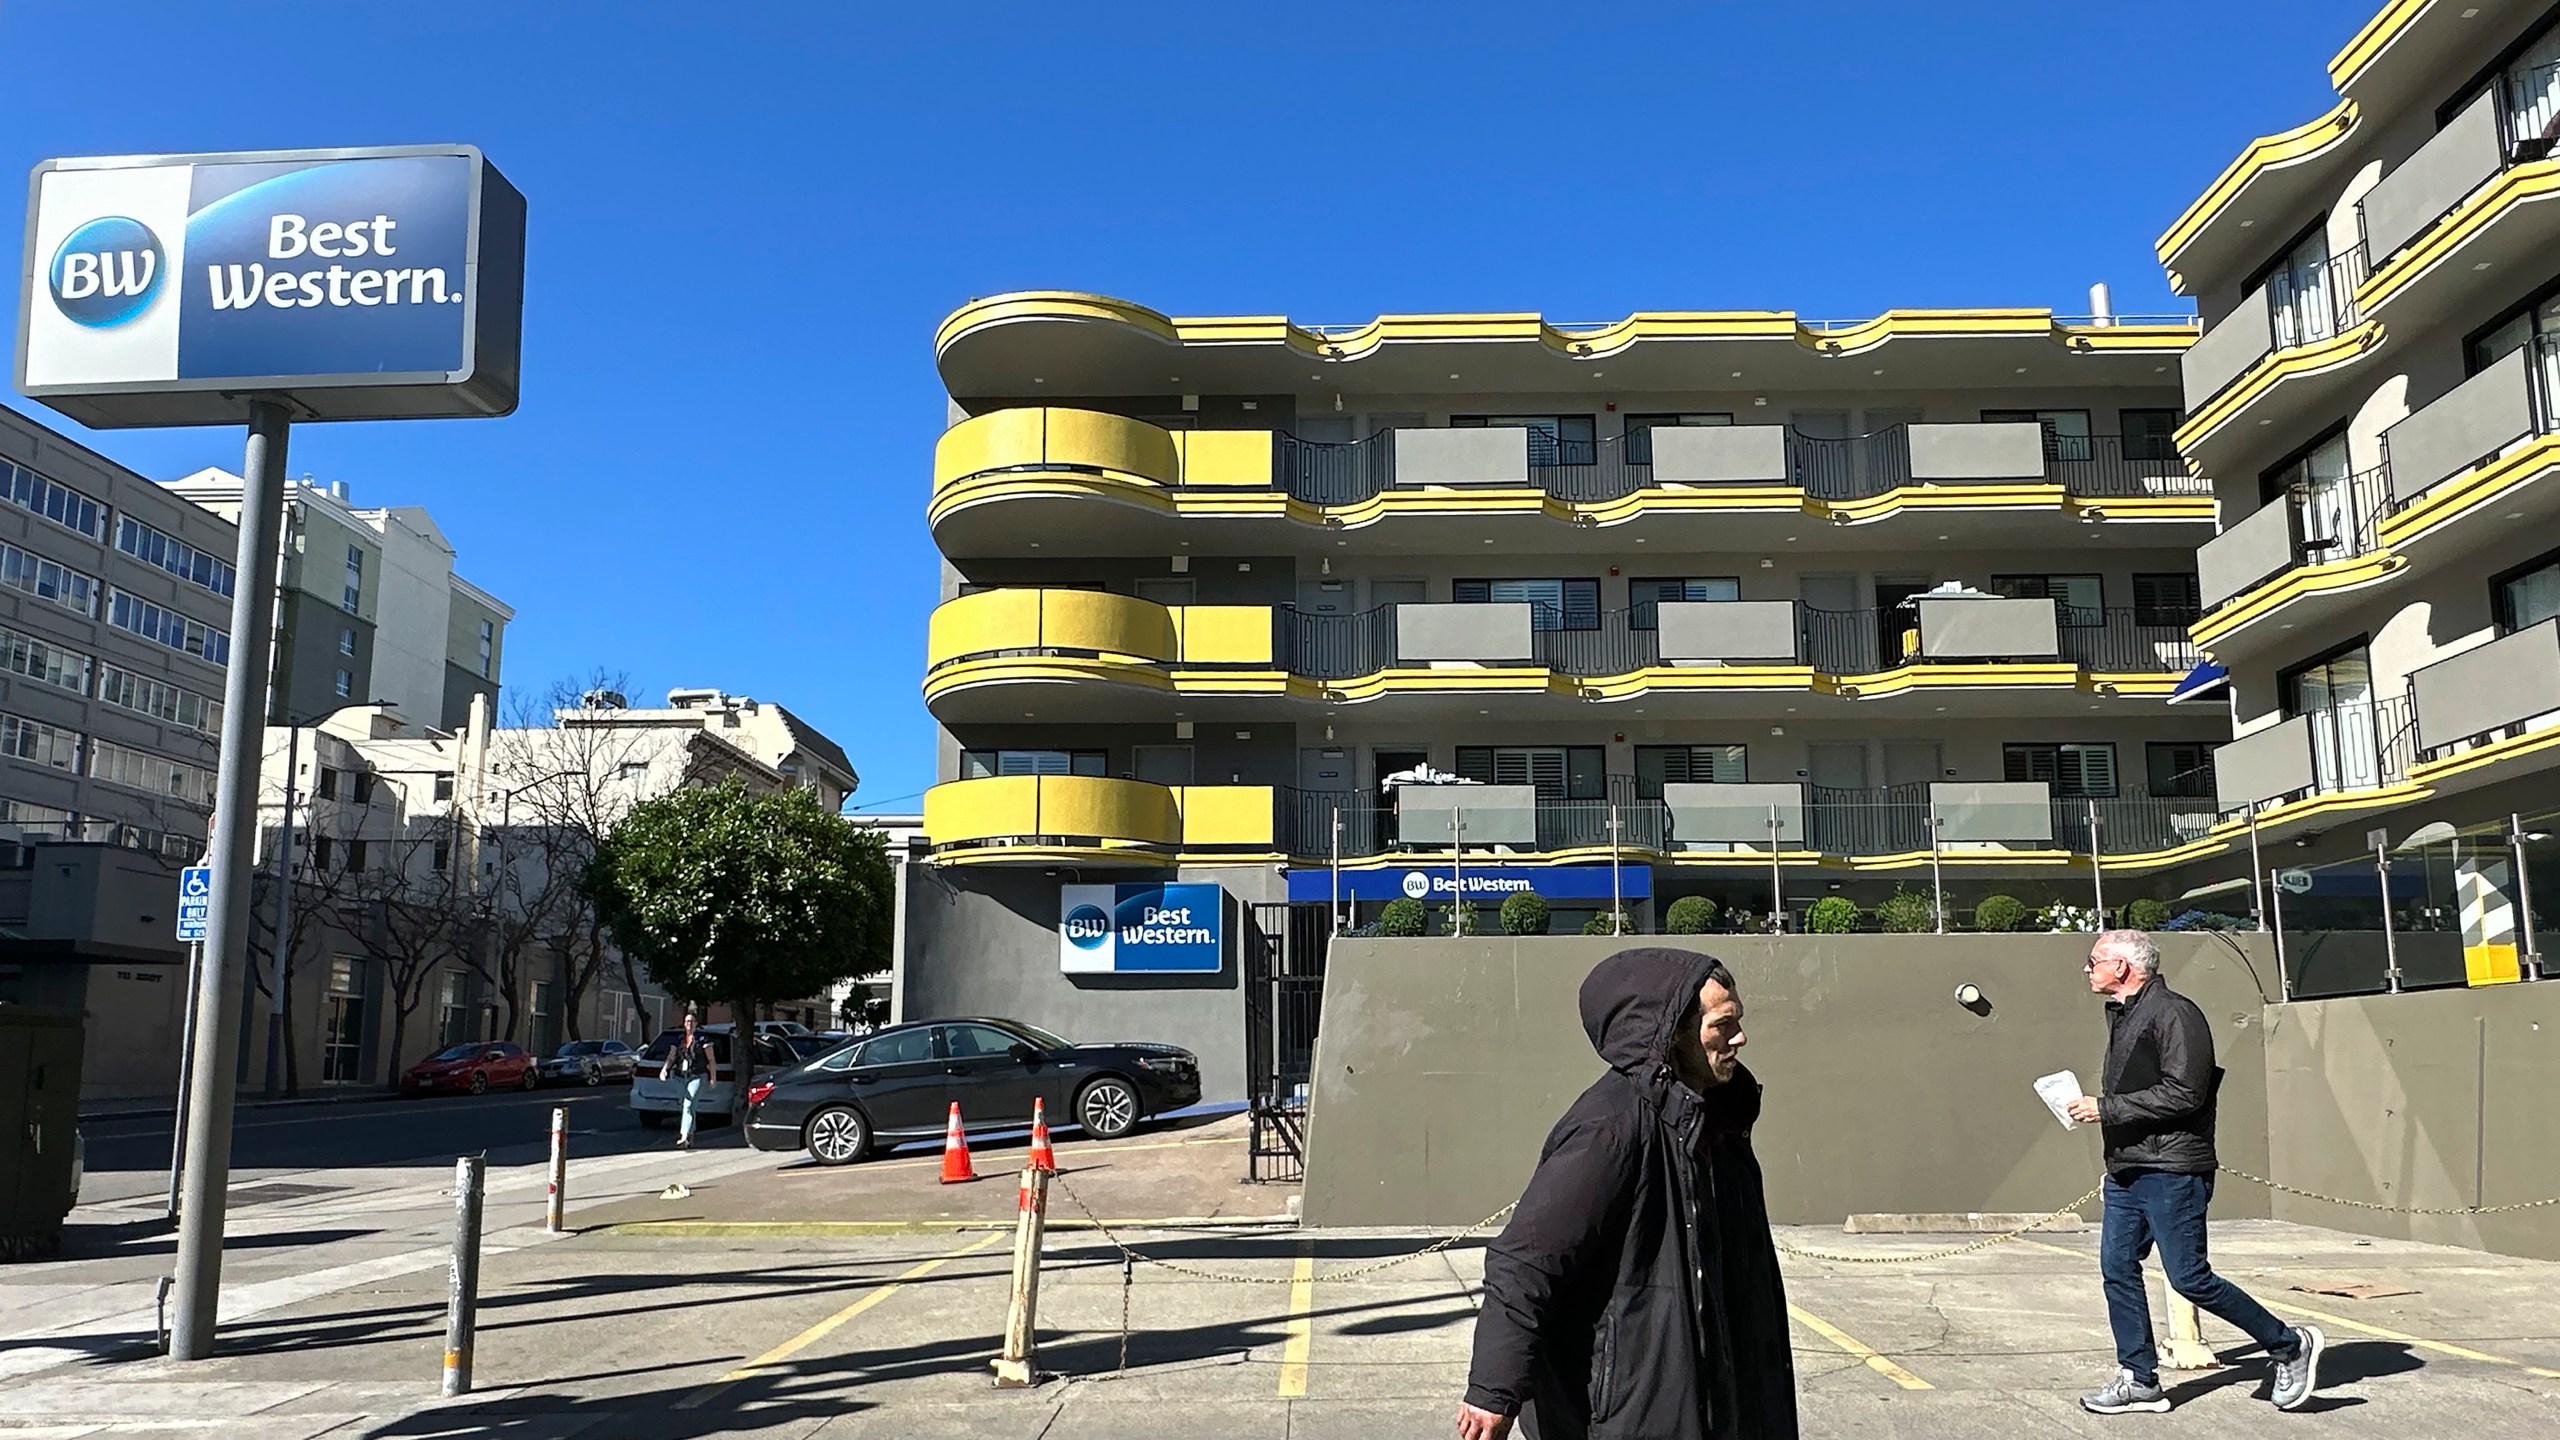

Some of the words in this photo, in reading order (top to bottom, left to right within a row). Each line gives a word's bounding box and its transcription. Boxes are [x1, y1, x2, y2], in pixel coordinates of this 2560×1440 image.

[268, 213, 397, 259] Best
[61, 248, 156, 300] BW
[1406, 879, 1426, 891] BW
[182, 896, 207, 906] PARKIN
[186, 907, 206, 918] ONLY
[1143, 906, 1191, 926] Best
[1069, 918, 1106, 938] BW
